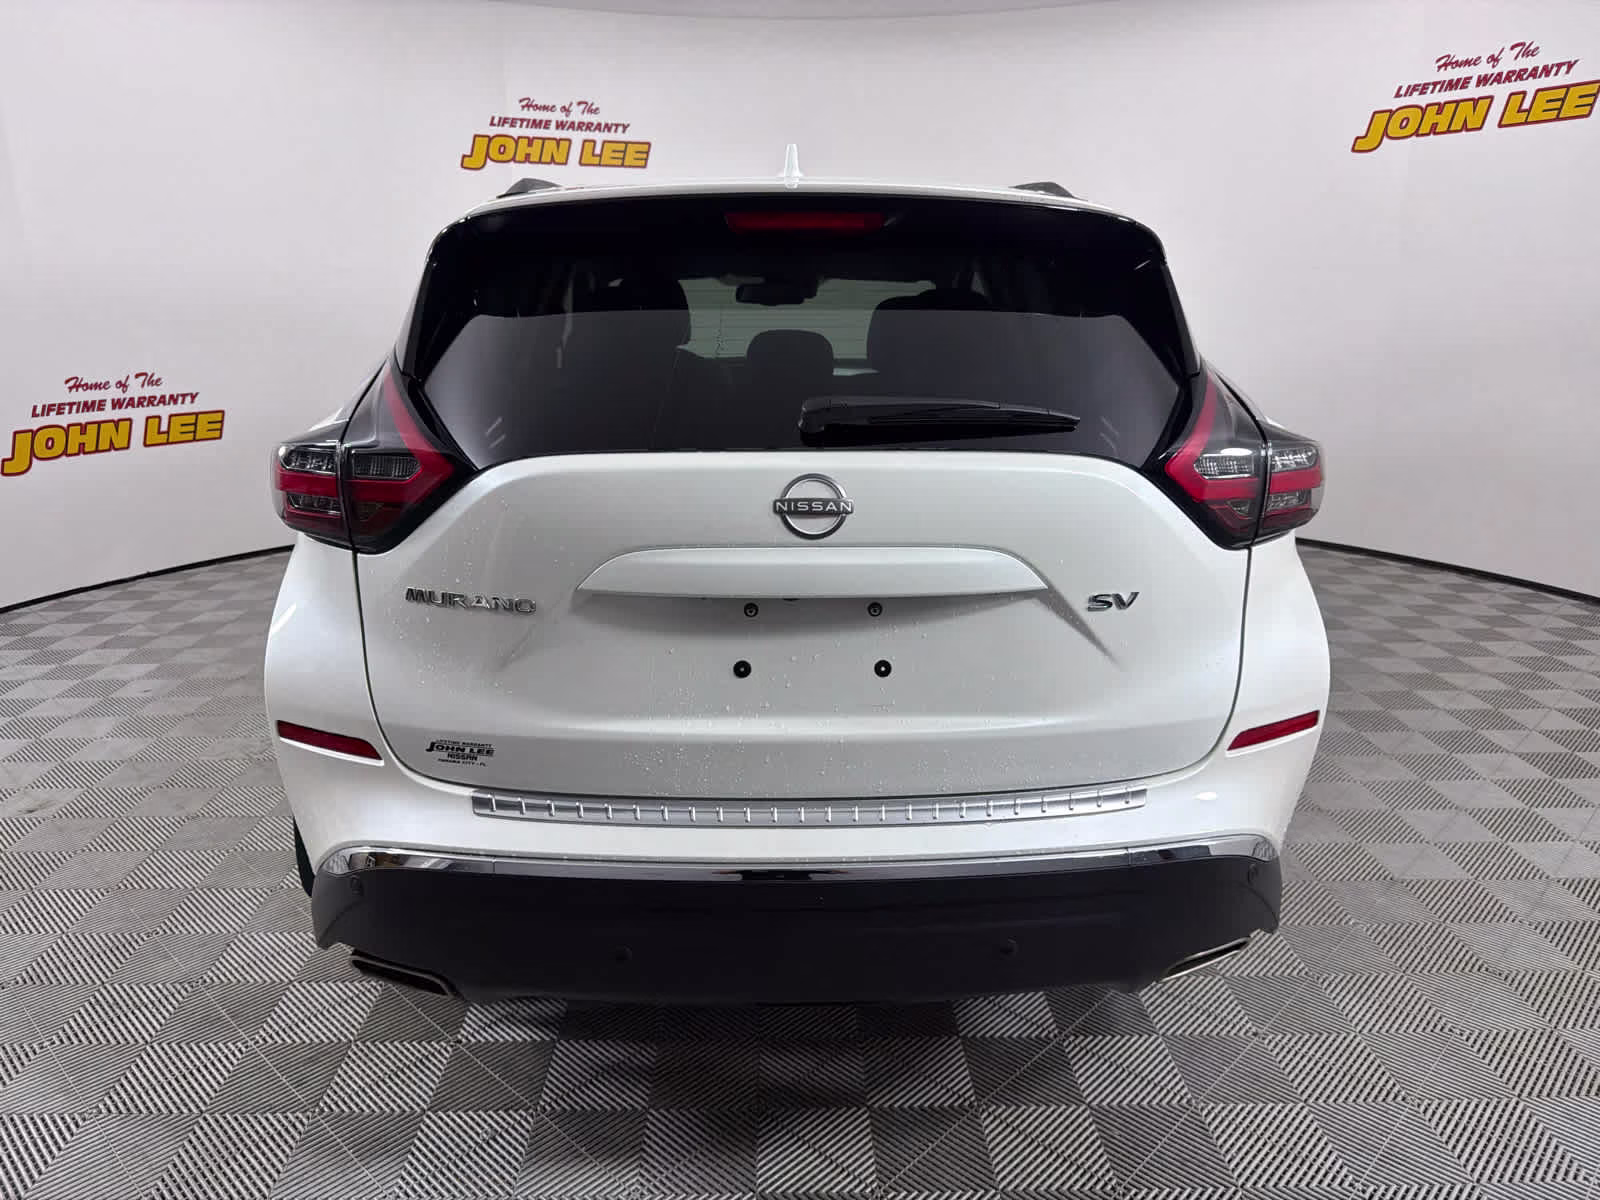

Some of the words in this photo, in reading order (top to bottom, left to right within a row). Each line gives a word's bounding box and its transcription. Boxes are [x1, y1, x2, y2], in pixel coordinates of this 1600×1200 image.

[1435, 54, 1482, 73] Home
[1486, 48, 1504, 69] of
[1509, 41, 1541, 61] The
[1393, 75, 1473, 98] LIFETIME
[1475, 59, 1580, 88] WARRANTY
[518, 96, 557, 113] Home
[559, 102, 574, 117] of
[576, 101, 601, 115] The
[1351, 95, 1495, 153] JOHN
[1497, 79, 1600, 128] LEE
[489, 115, 553, 130] LIFETIME
[555, 120, 630, 134] WARRANTY
[460, 134, 572, 170] JOHN
[578, 139, 651, 169] LEE
[64, 376, 111, 394] Home
[115, 374, 130, 394] of
[134, 371, 163, 389] The
[31, 398, 108, 418] LIFETIME
[111, 392, 200, 410] WARRANTY
[1, 418, 133, 476] JOHN
[143, 410, 225, 448] LEE
[774, 500, 852, 513] NISSAN
[405, 587, 537, 613] MURANO
[1087, 591, 1140, 612] SV
[425, 741, 466, 753] JOHN
[469, 747, 496, 757] LEE
[447, 752, 478, 761] NISSAN
